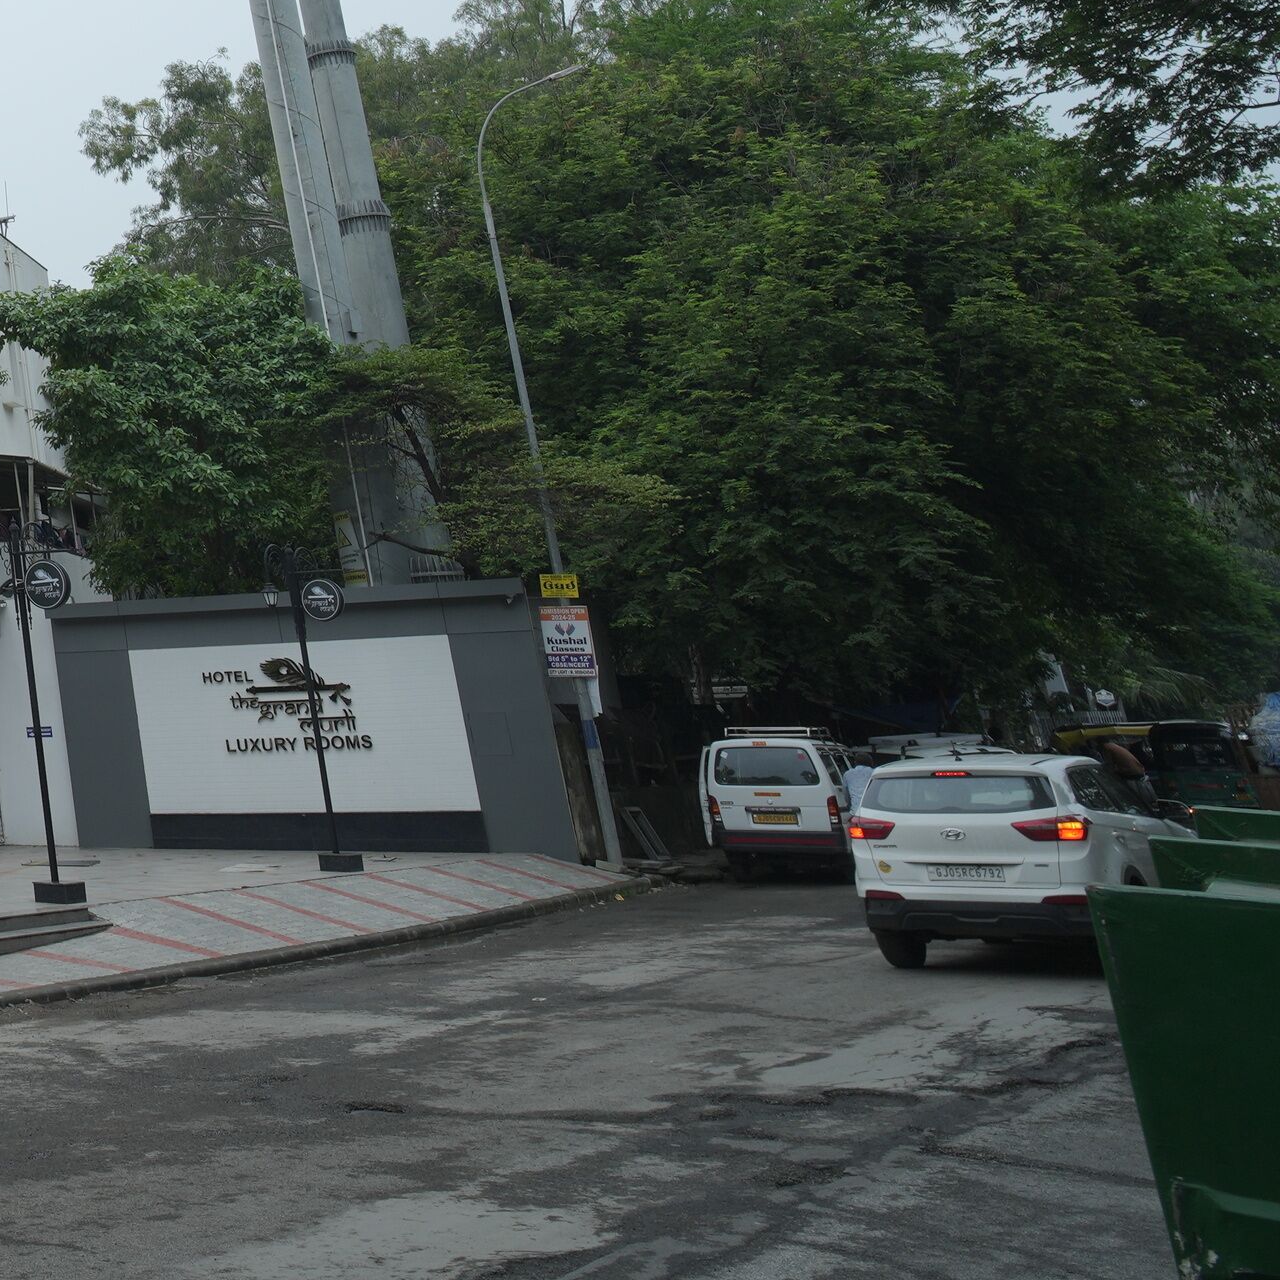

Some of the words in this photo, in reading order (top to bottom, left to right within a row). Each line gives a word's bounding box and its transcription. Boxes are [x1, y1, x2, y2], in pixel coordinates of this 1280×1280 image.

[547, 637, 587, 645] Kushal
[202, 671, 254, 685] HOTEL
[229, 692, 258, 709] the
[257, 691, 323, 724] grand
[297, 708, 356, 732] murli
[226, 737, 297, 753] LUXURY
[304, 734, 373, 751] ROOMS
[935, 866, 1003, 879] GJ05RC6792
